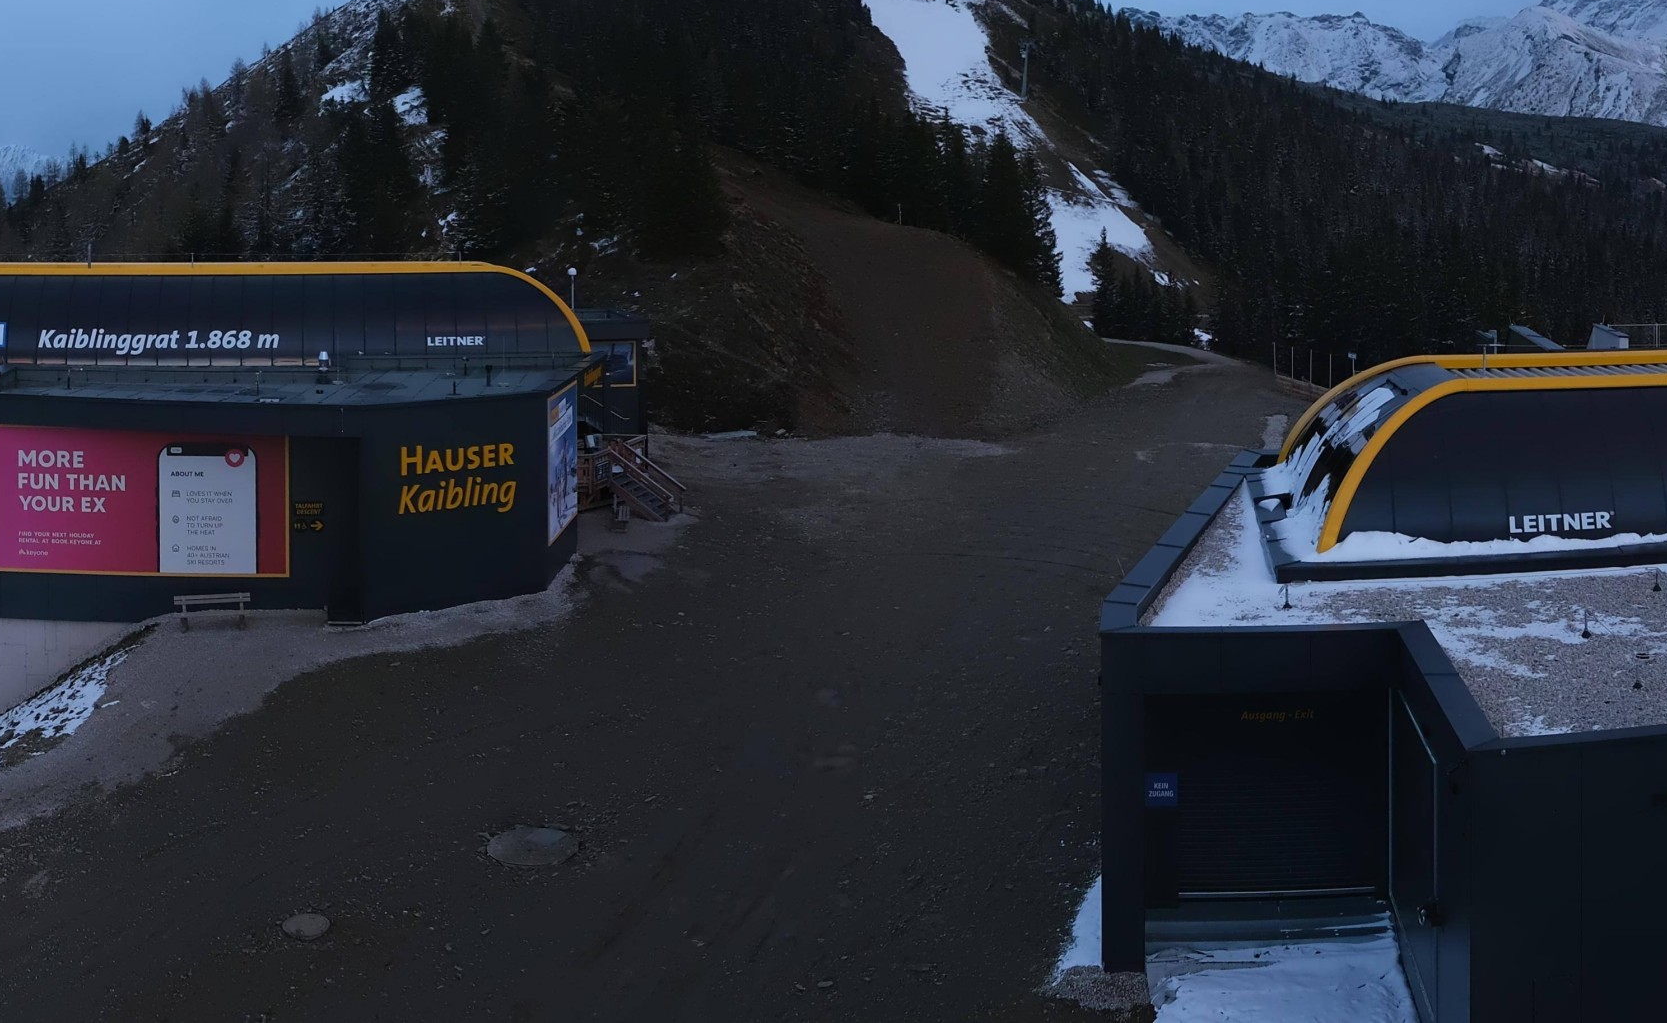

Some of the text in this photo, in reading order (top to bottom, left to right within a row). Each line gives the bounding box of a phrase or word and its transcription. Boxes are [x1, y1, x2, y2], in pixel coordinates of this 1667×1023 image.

[38, 328, 280, 356] Kaiblinggrat 1.868 m
[18, 450, 84, 468] MORE
[400, 443, 515, 476] HAUSER
[18, 473, 126, 491] FUN THAN
[19, 495, 106, 513] YOUR EX
[398, 477, 518, 515] Kaibling
[1509, 511, 1612, 533] LEITNER
[26, 549, 49, 557] keyone
[1240, 710, 1286, 722] Ausgang
[1294, 708, 1314, 719] Exit
